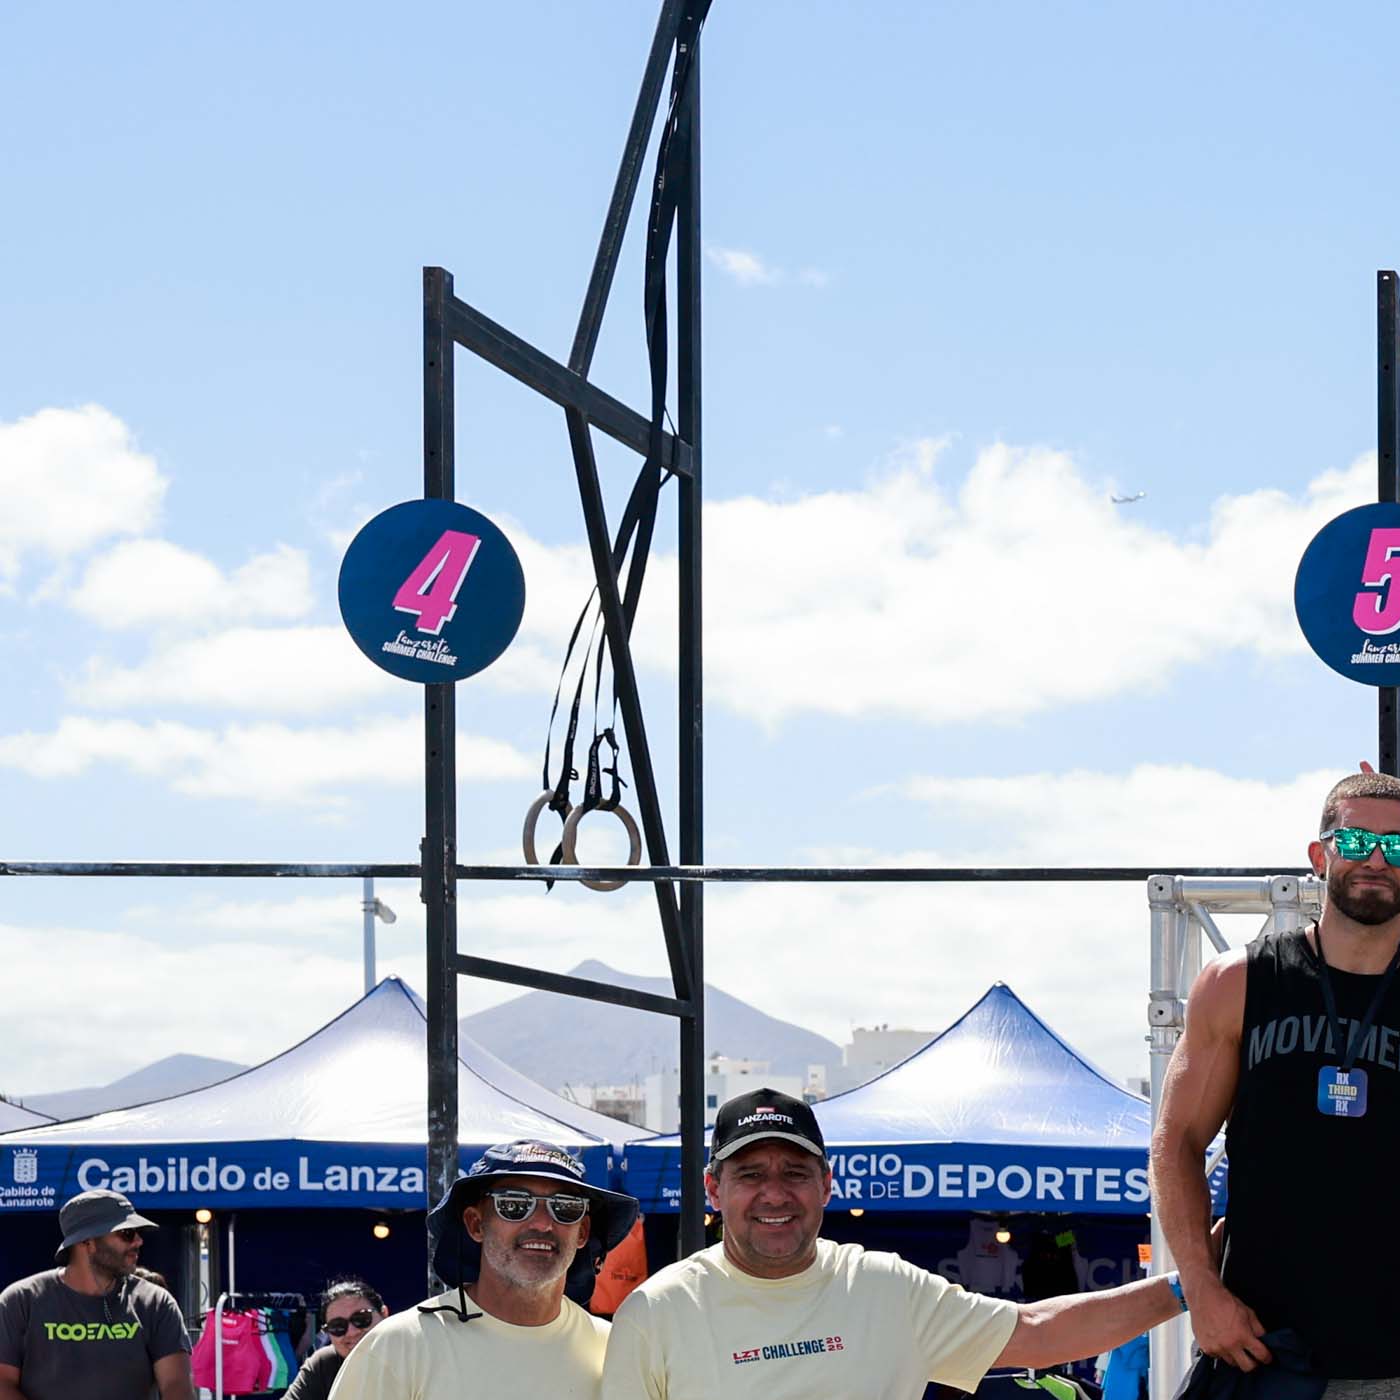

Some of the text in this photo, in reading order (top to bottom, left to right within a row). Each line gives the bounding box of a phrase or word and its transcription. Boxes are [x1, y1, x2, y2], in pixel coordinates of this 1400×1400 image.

[392, 529, 482, 635] 4
[382, 642, 457, 666] SUMMER CHALLENGE
[1351, 653, 1384, 664] SUMMER
[1328, 1084, 1357, 1096] THIRD
[77, 1156, 424, 1193] Cabildo de Lanza
[870, 1181, 900, 1198] DE
[903, 1164, 1150, 1201] DEPORTES
[41, 1185, 55, 1196] de
[733, 1336, 842, 1360] LZT CHALLENGE 20
